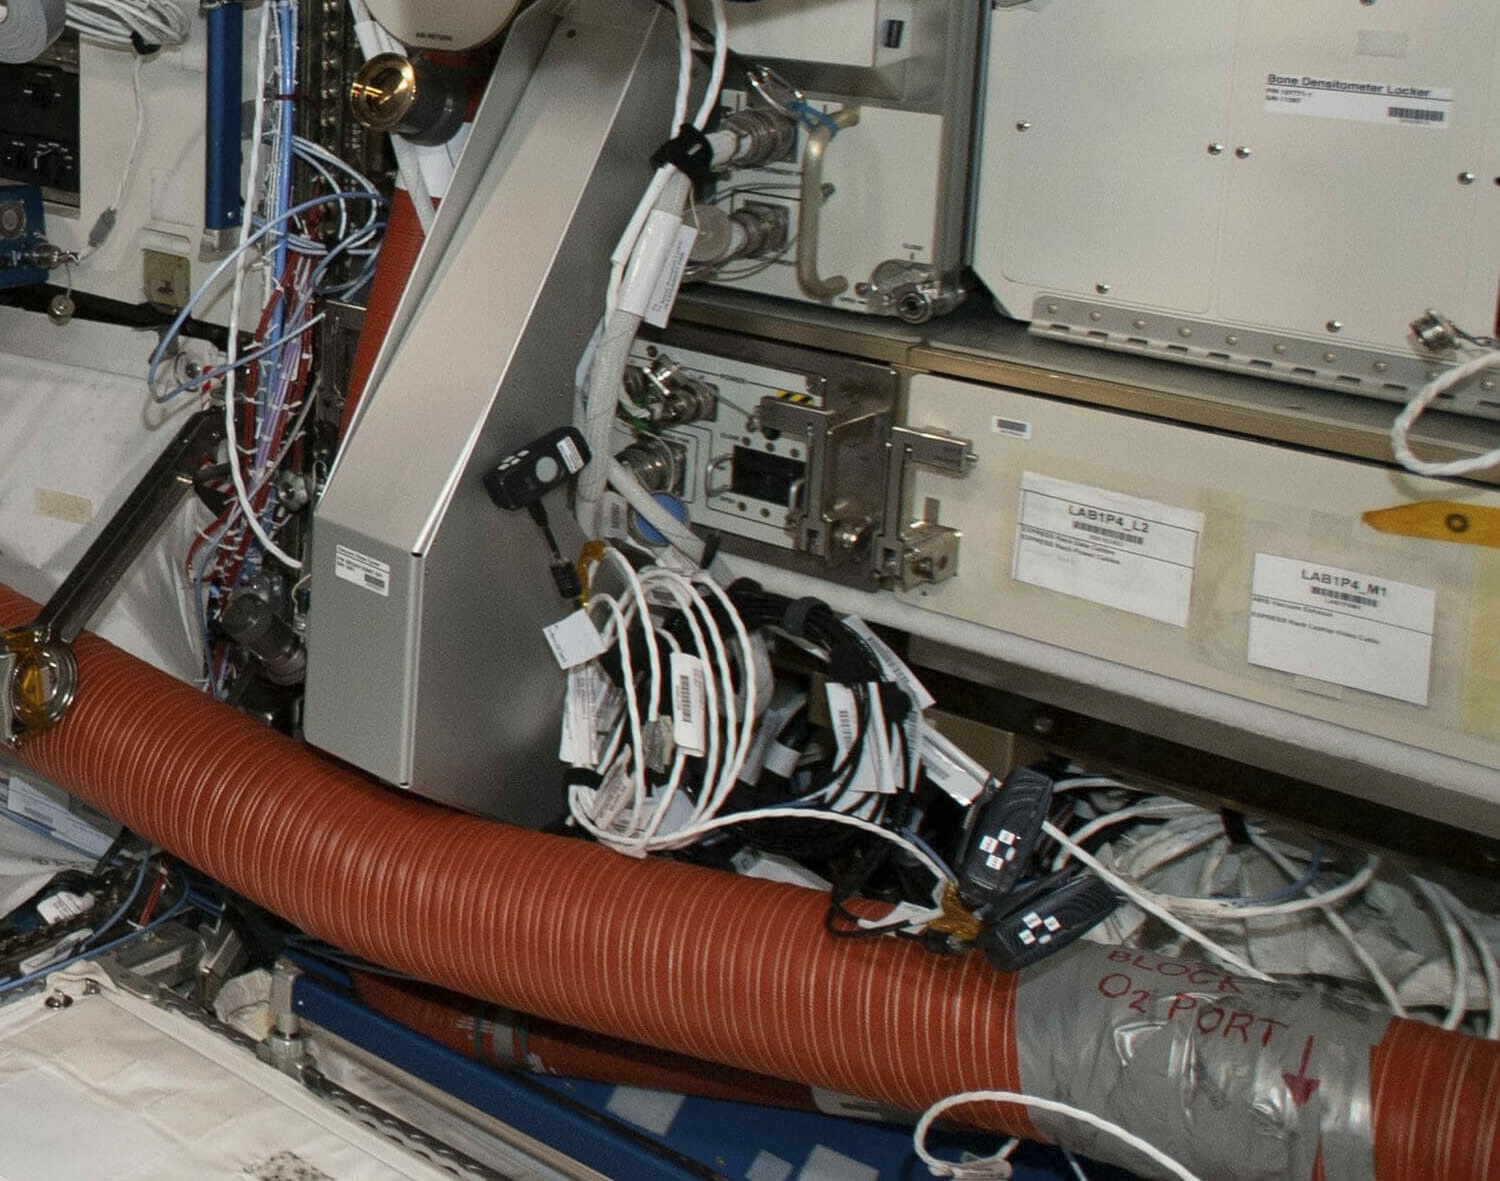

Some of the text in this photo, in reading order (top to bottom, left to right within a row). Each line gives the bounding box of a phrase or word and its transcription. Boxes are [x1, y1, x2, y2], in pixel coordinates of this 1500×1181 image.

[1267, 73, 1431, 97] Bone Densitometer Locker
[1068, 504, 1151, 533] LAB1P4_L2
[1301, 569, 1388, 597] LAB1P4_M1
[1167, 992, 1290, 1048] PORT
